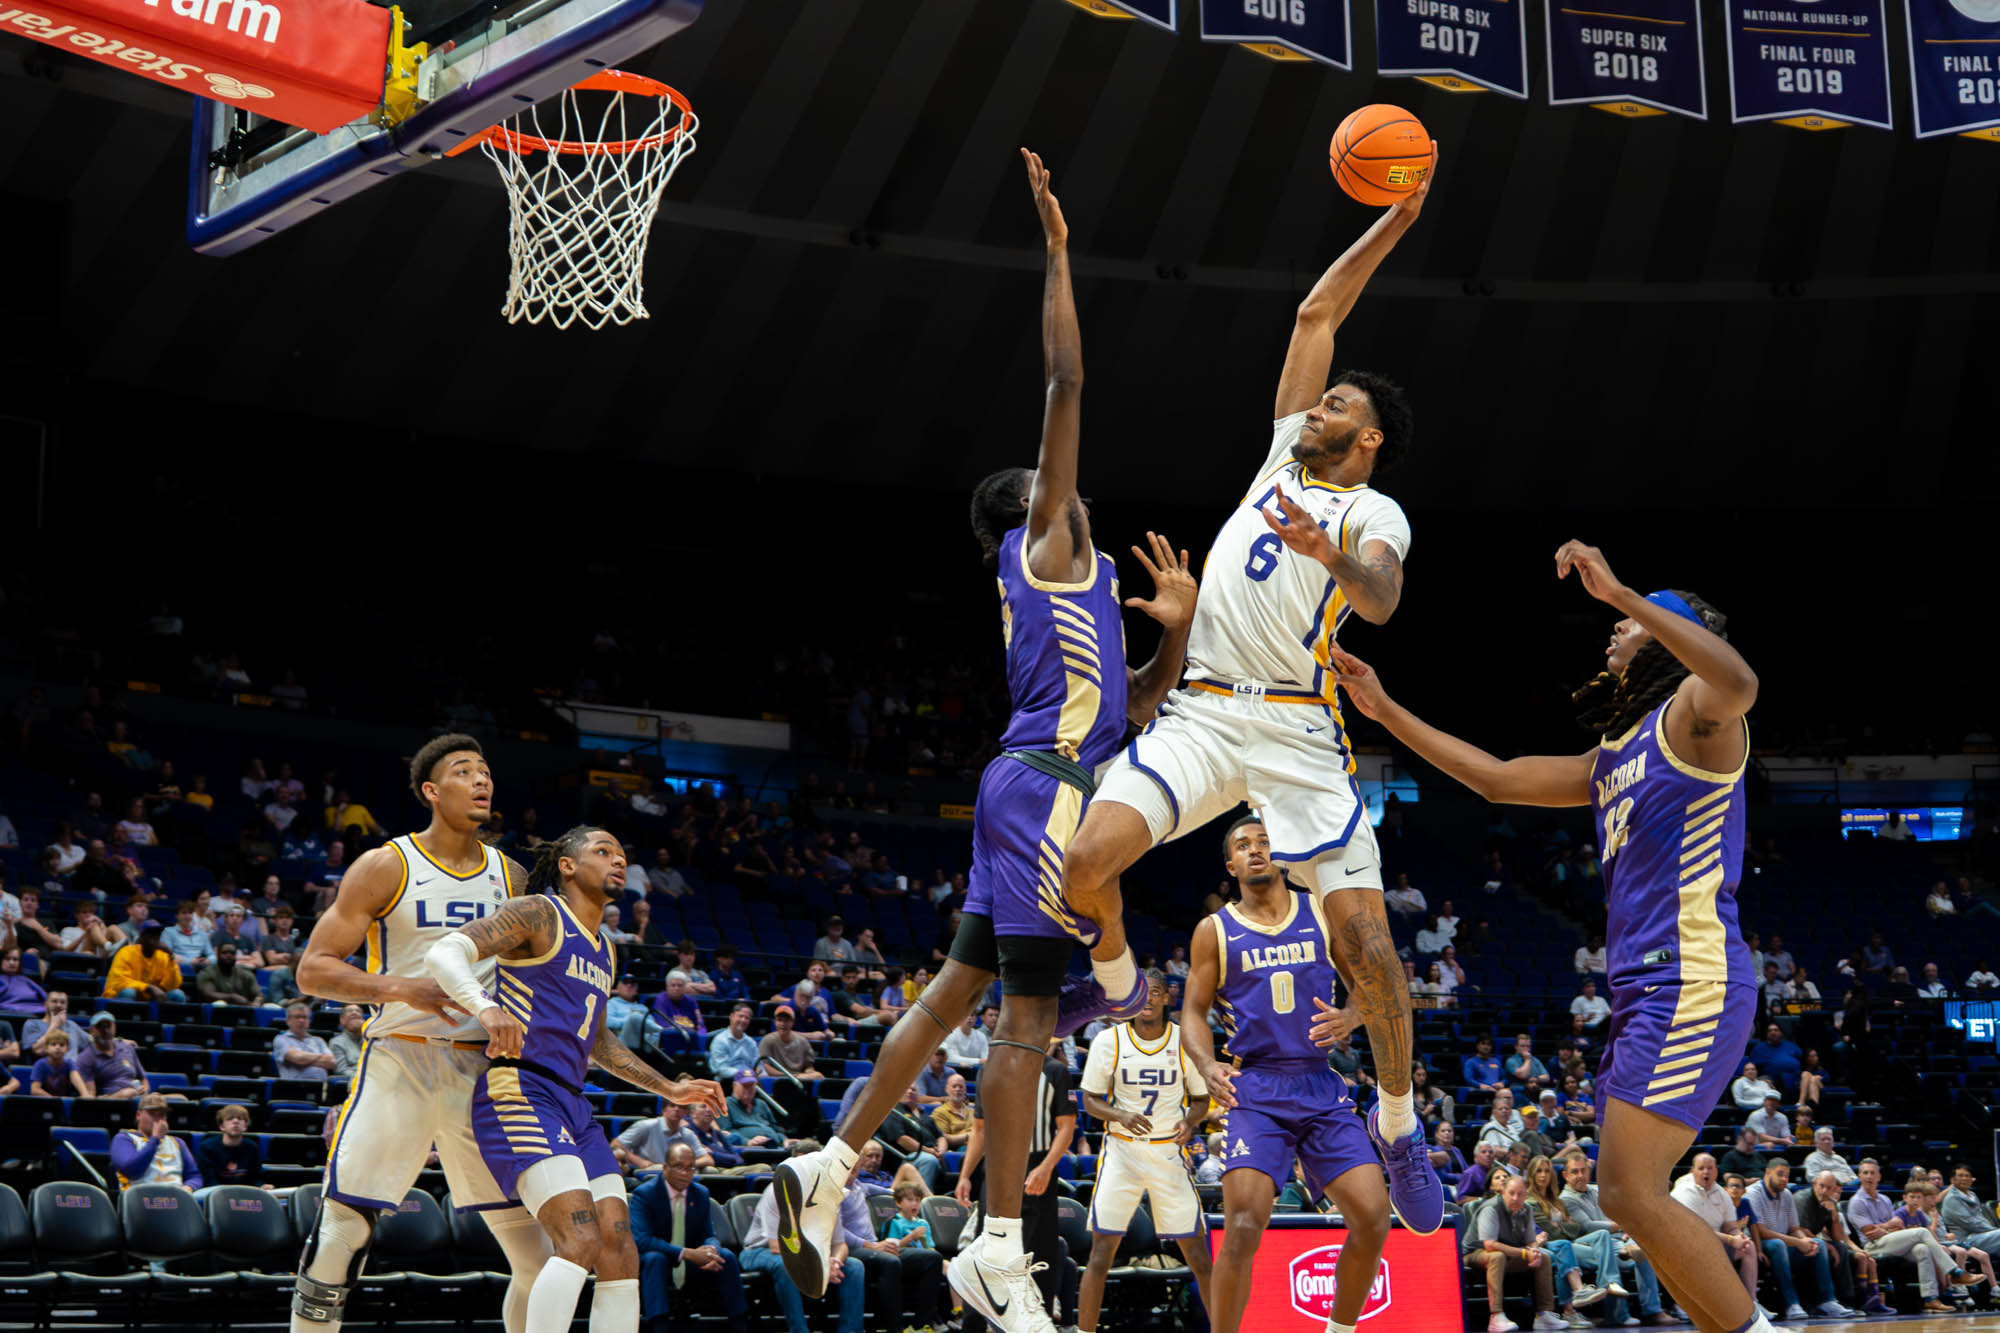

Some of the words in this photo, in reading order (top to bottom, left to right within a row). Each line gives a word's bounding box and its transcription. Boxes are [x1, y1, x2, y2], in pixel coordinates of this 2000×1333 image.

[144, 0, 281, 43] arm
[1407, 0, 1460, 21] SUPER
[1465, 8, 1490, 28] SIX
[1743, 9, 1799, 23] NATIONAL
[1802, 13, 1869, 26] RUNNER-UP
[1420, 22, 1480, 57] 2017
[1581, 28, 1636, 48] SUPER
[1640, 33, 1668, 52] SIX
[1593, 50, 1659, 82] 2018
[1760, 44, 1808, 62] FINAL
[1812, 46, 1856, 64] FOUR
[1943, 56, 1993, 72] FINAL
[1777, 66, 1843, 94] 2019
[1958, 77, 2000, 105] 20
[1244, 532, 1283, 582] 6
[1237, 684, 1262, 695] LSU
[1595, 750, 1648, 809] ALCORN
[1601, 796, 1636, 865] 12
[1241, 940, 1317, 973] ALCORN
[1270, 971, 1296, 1015] 0
[577, 993, 597, 1041] 1
[1121, 1068, 1178, 1086] LSU
[1140, 1090, 1160, 1116] 7
